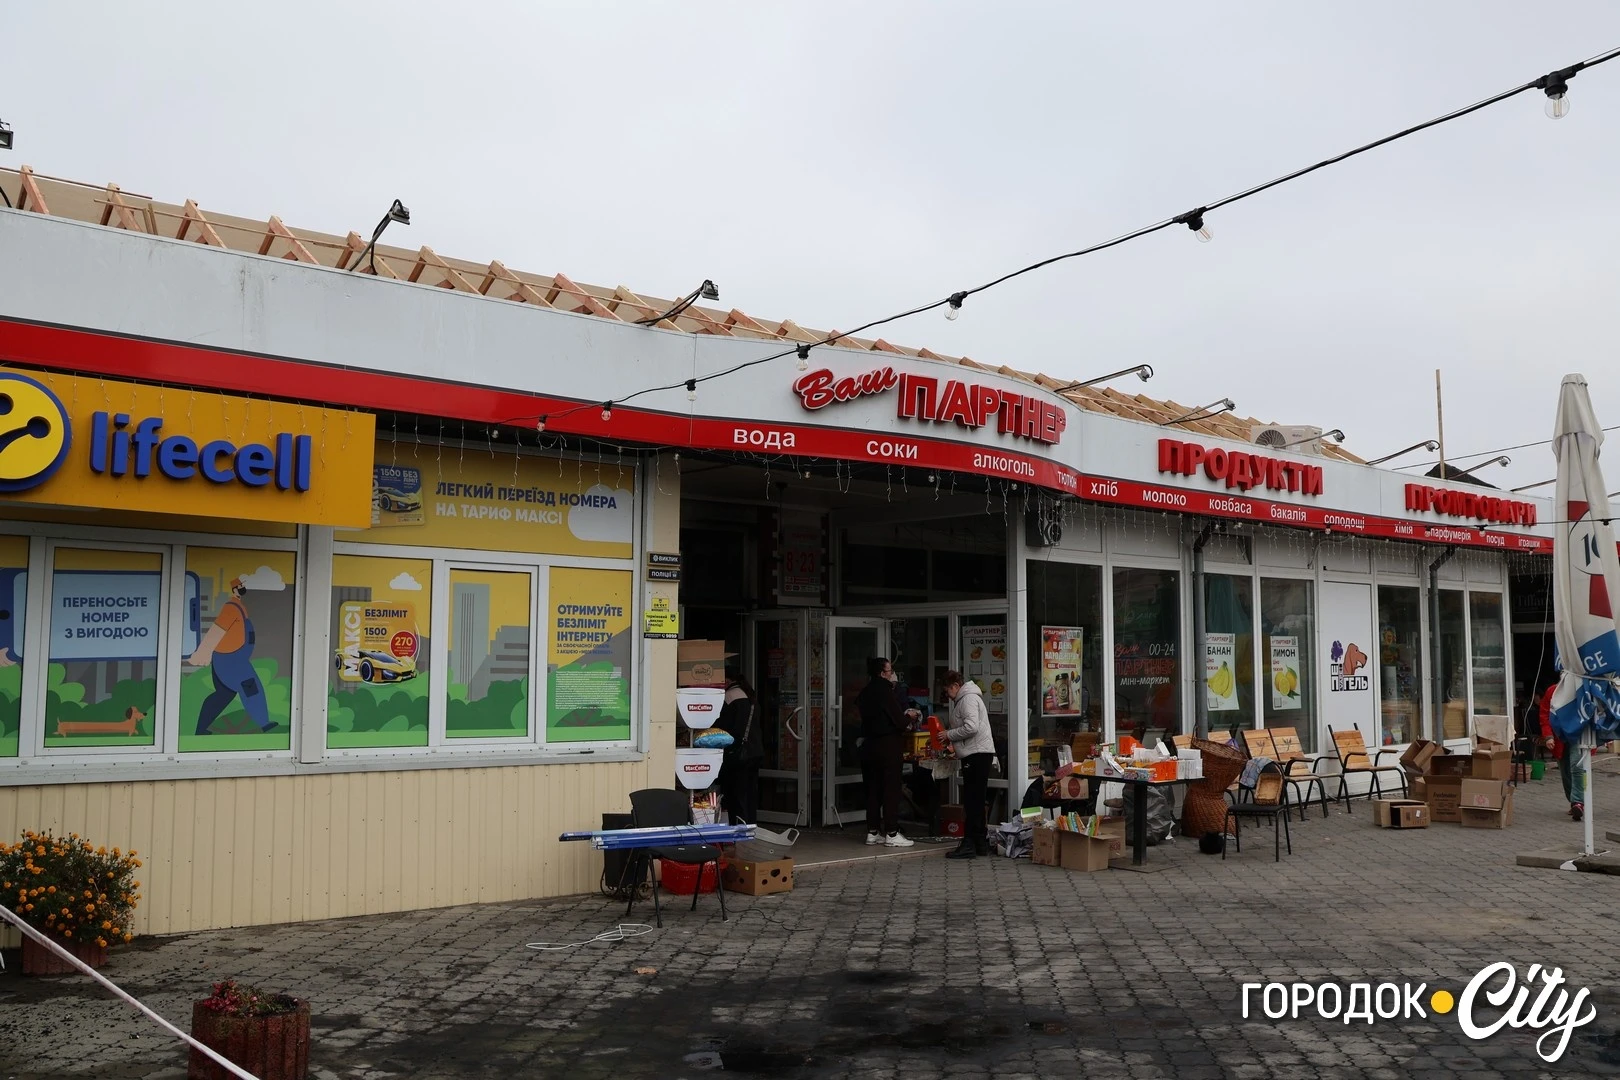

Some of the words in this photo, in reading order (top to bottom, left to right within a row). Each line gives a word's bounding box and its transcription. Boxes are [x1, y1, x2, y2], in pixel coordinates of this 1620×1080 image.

[792, 367, 898, 412] Ваш
[897, 372, 1068, 446] ПАРТНЕР
[733, 428, 796, 450] вода
[90, 411, 312, 493] lifecell
[866, 440, 918, 460] соки
[380, 468, 401, 477] 1500
[973, 453, 1035, 477] алкоголь
[1157, 438, 1323, 496] ПРОДУКТИ
[435, 481, 494, 500] ЛЕГКИЙ
[498, 485, 556, 507] ПЕРЕЇЗД
[560, 493, 618, 510] НОМЕРА
[1090, 480, 1118, 497] хліб
[1142, 490, 1187, 507] молоко
[1209, 497, 1252, 515] ковбаса
[1404, 483, 1538, 527] ПРОМТОВАРИ
[435, 502, 458, 518] НА
[461, 504, 512, 521] ТАРИФ
[516, 508, 563, 525] МАКСІ
[1270, 504, 1307, 522] бакалія
[1394, 521, 1414, 535] хімія
[1430, 527, 1472, 542] парфумерія
[1486, 535, 1505, 546] посуд
[62, 596, 148, 609] ПЕРЕНОСЬТЕ
[557, 603, 623, 617] ОТРИМУЙТЕ
[81, 611, 130, 624] НОМЕР
[365, 608, 408, 618] БЕЗЛІМІТ
[557, 617, 607, 629] БЕЗЛІМІТ
[64, 627, 73, 639] З
[76, 626, 149, 640] ВИГОДОЮ
[364, 627, 387, 636] 1500
[557, 631, 613, 642] ІНТЕРНЕТУ
[344, 605, 361, 677] МАКСІ
[395, 636, 413, 647] 270
[1149, 643, 1175, 656] 00-24
[1207, 646, 1232, 656] БАНАН
[1273, 649, 1296, 658] ЛИМОН
[1115, 658, 1175, 676] ПАРТНЕР
